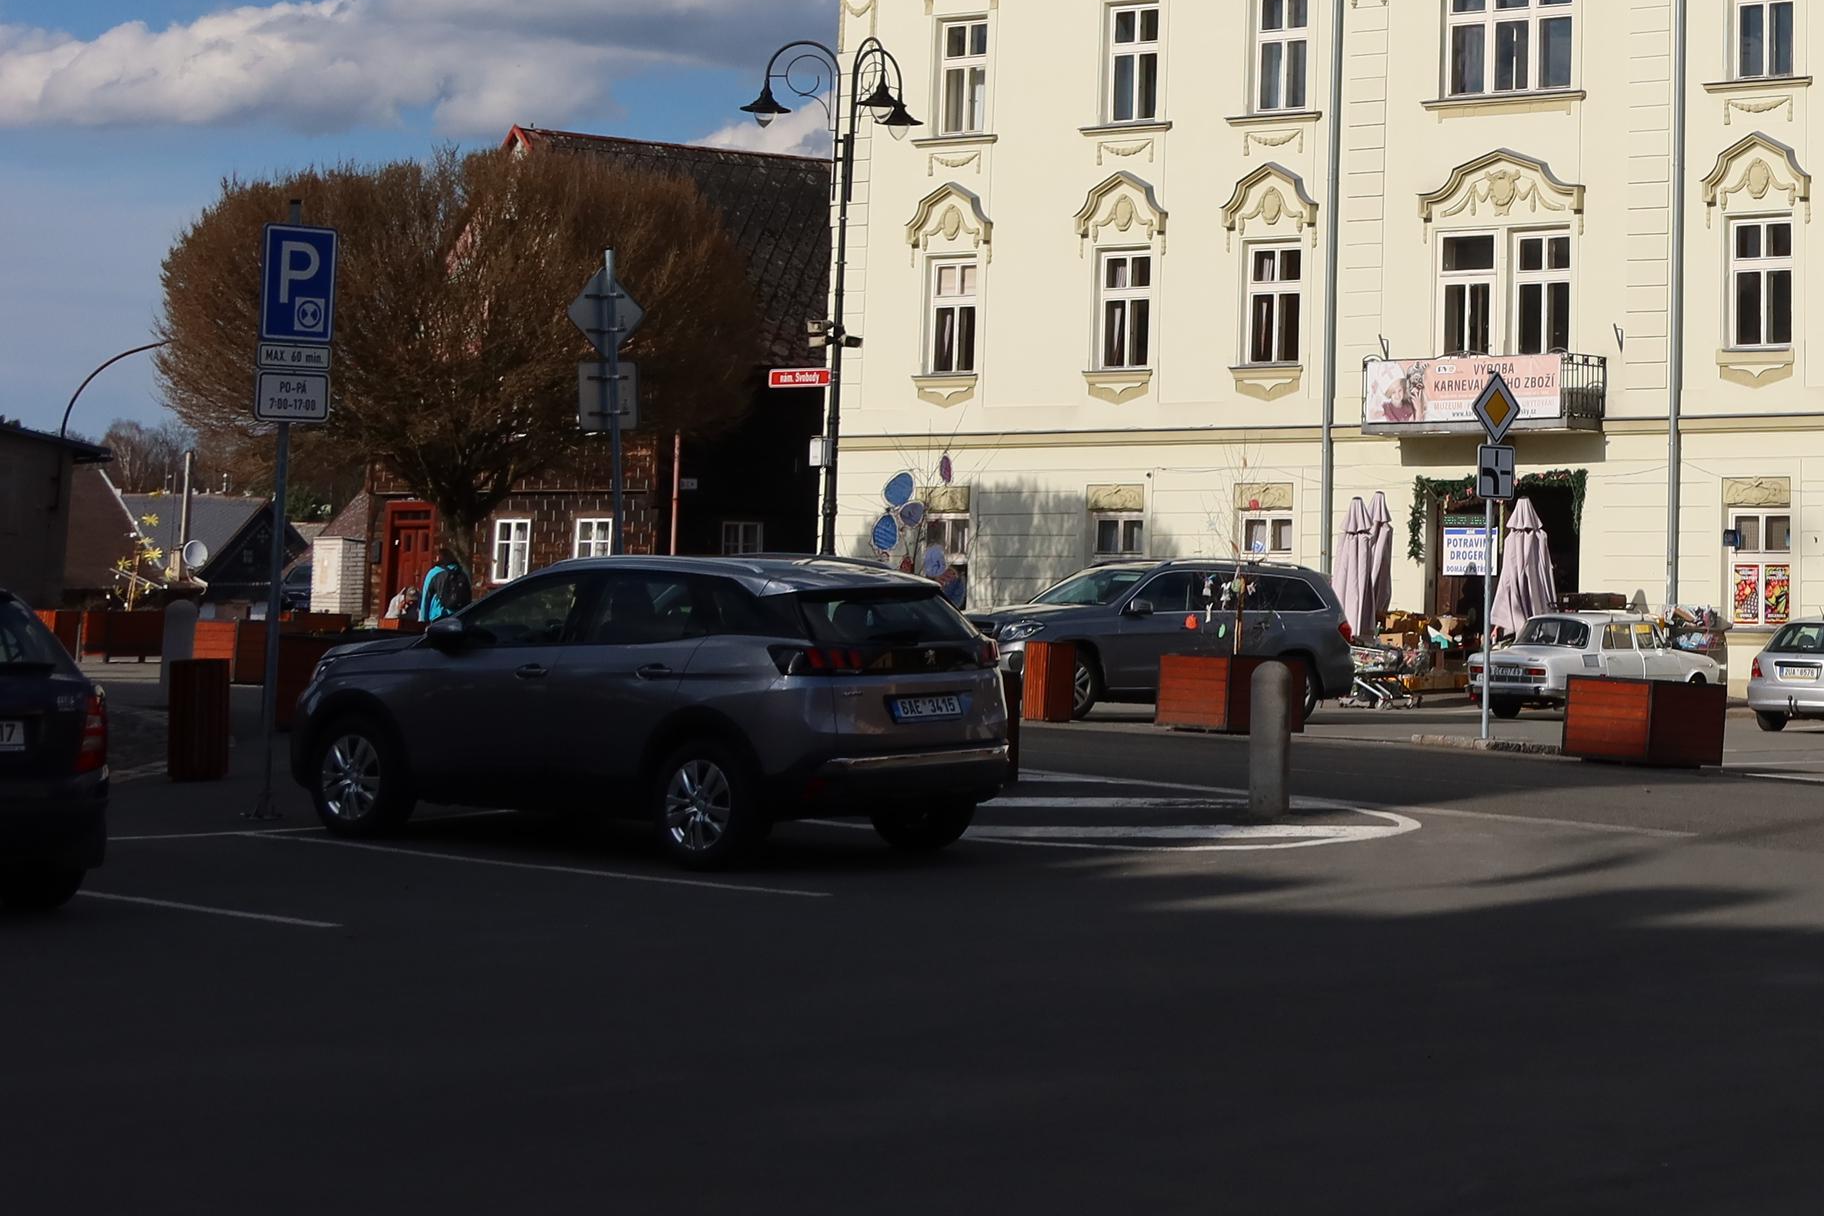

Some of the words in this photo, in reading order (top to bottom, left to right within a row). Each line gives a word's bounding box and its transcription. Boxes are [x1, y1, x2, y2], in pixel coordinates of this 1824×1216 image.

[280, 240, 320, 304] P
[265, 349, 286, 362] MAX.
[291, 351, 302, 363] 60
[305, 352, 324, 364] min.
[1474, 361, 1515, 376] VÝROBA
[780, 372, 794, 383] nám.
[795, 371, 820, 385] Svobody
[1434, 374, 1521, 393] KARNEVALHO
[1524, 372, 1556, 388] ZBOŽÍ
[279, 379, 308, 395] PO-PÁ
[269, 397, 317, 412] 7:00-17:00
[1450, 550, 1487, 561] DROGERI
